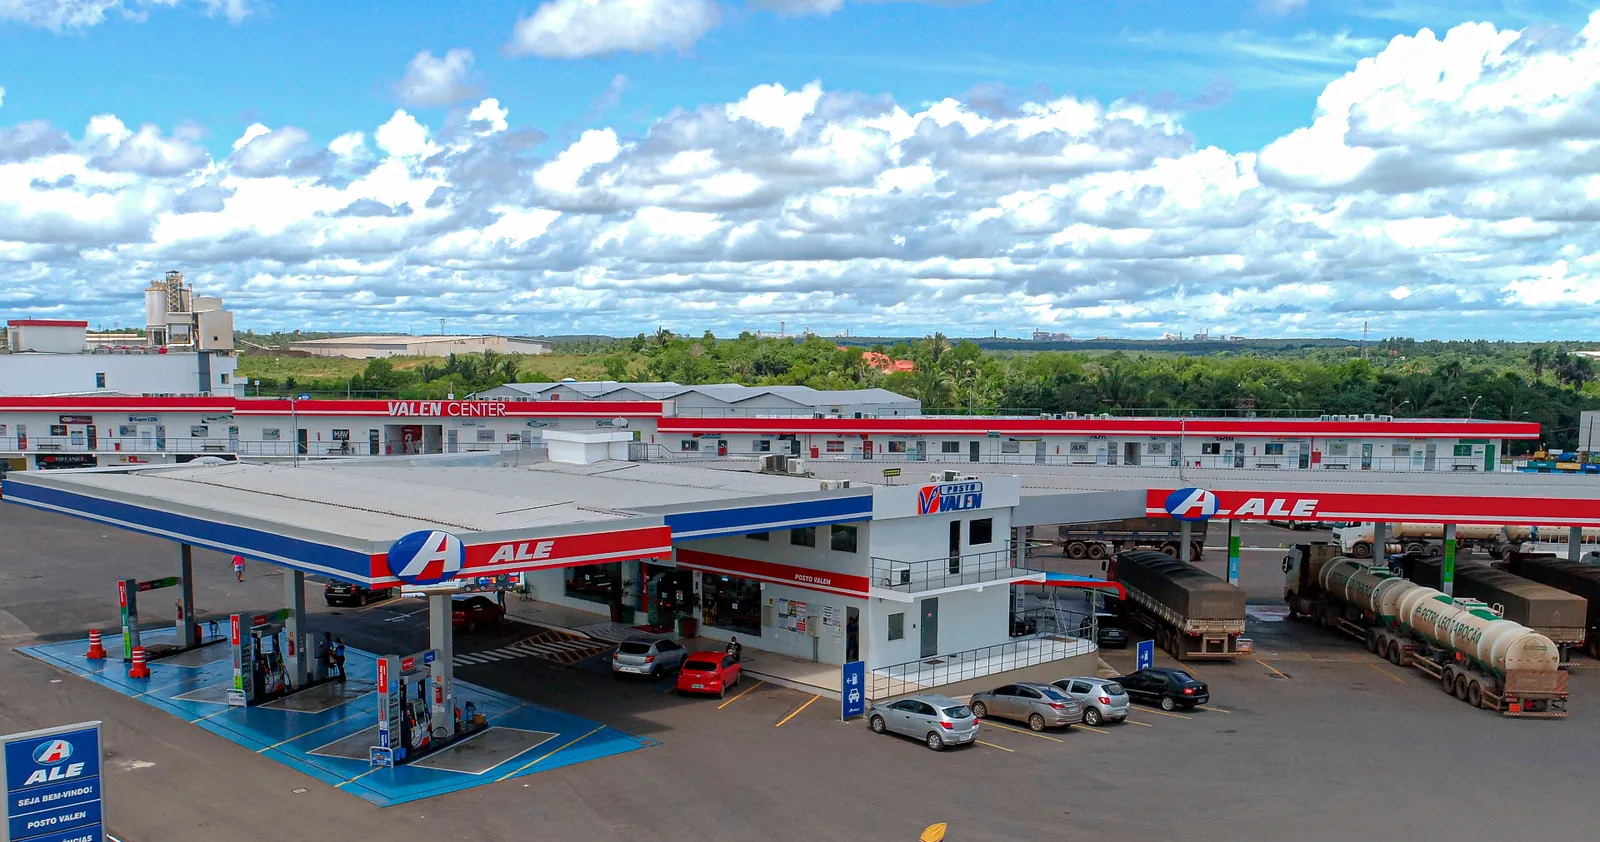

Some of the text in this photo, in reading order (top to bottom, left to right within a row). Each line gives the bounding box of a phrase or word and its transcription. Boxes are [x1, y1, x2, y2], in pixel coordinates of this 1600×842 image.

[387, 401, 506, 417] VALEN CENTER
[947, 484, 976, 493] POSTO
[939, 493, 982, 512] VALEN
[1234, 498, 1319, 516] ALE
[488, 540, 554, 563] ALE
[794, 574, 831, 585] POSTO VALEN
[24, 762, 85, 786] ALE
[18, 786, 93, 807] SEJA BEM-VINDO!
[27, 811, 86, 830] POSTO VALEN
